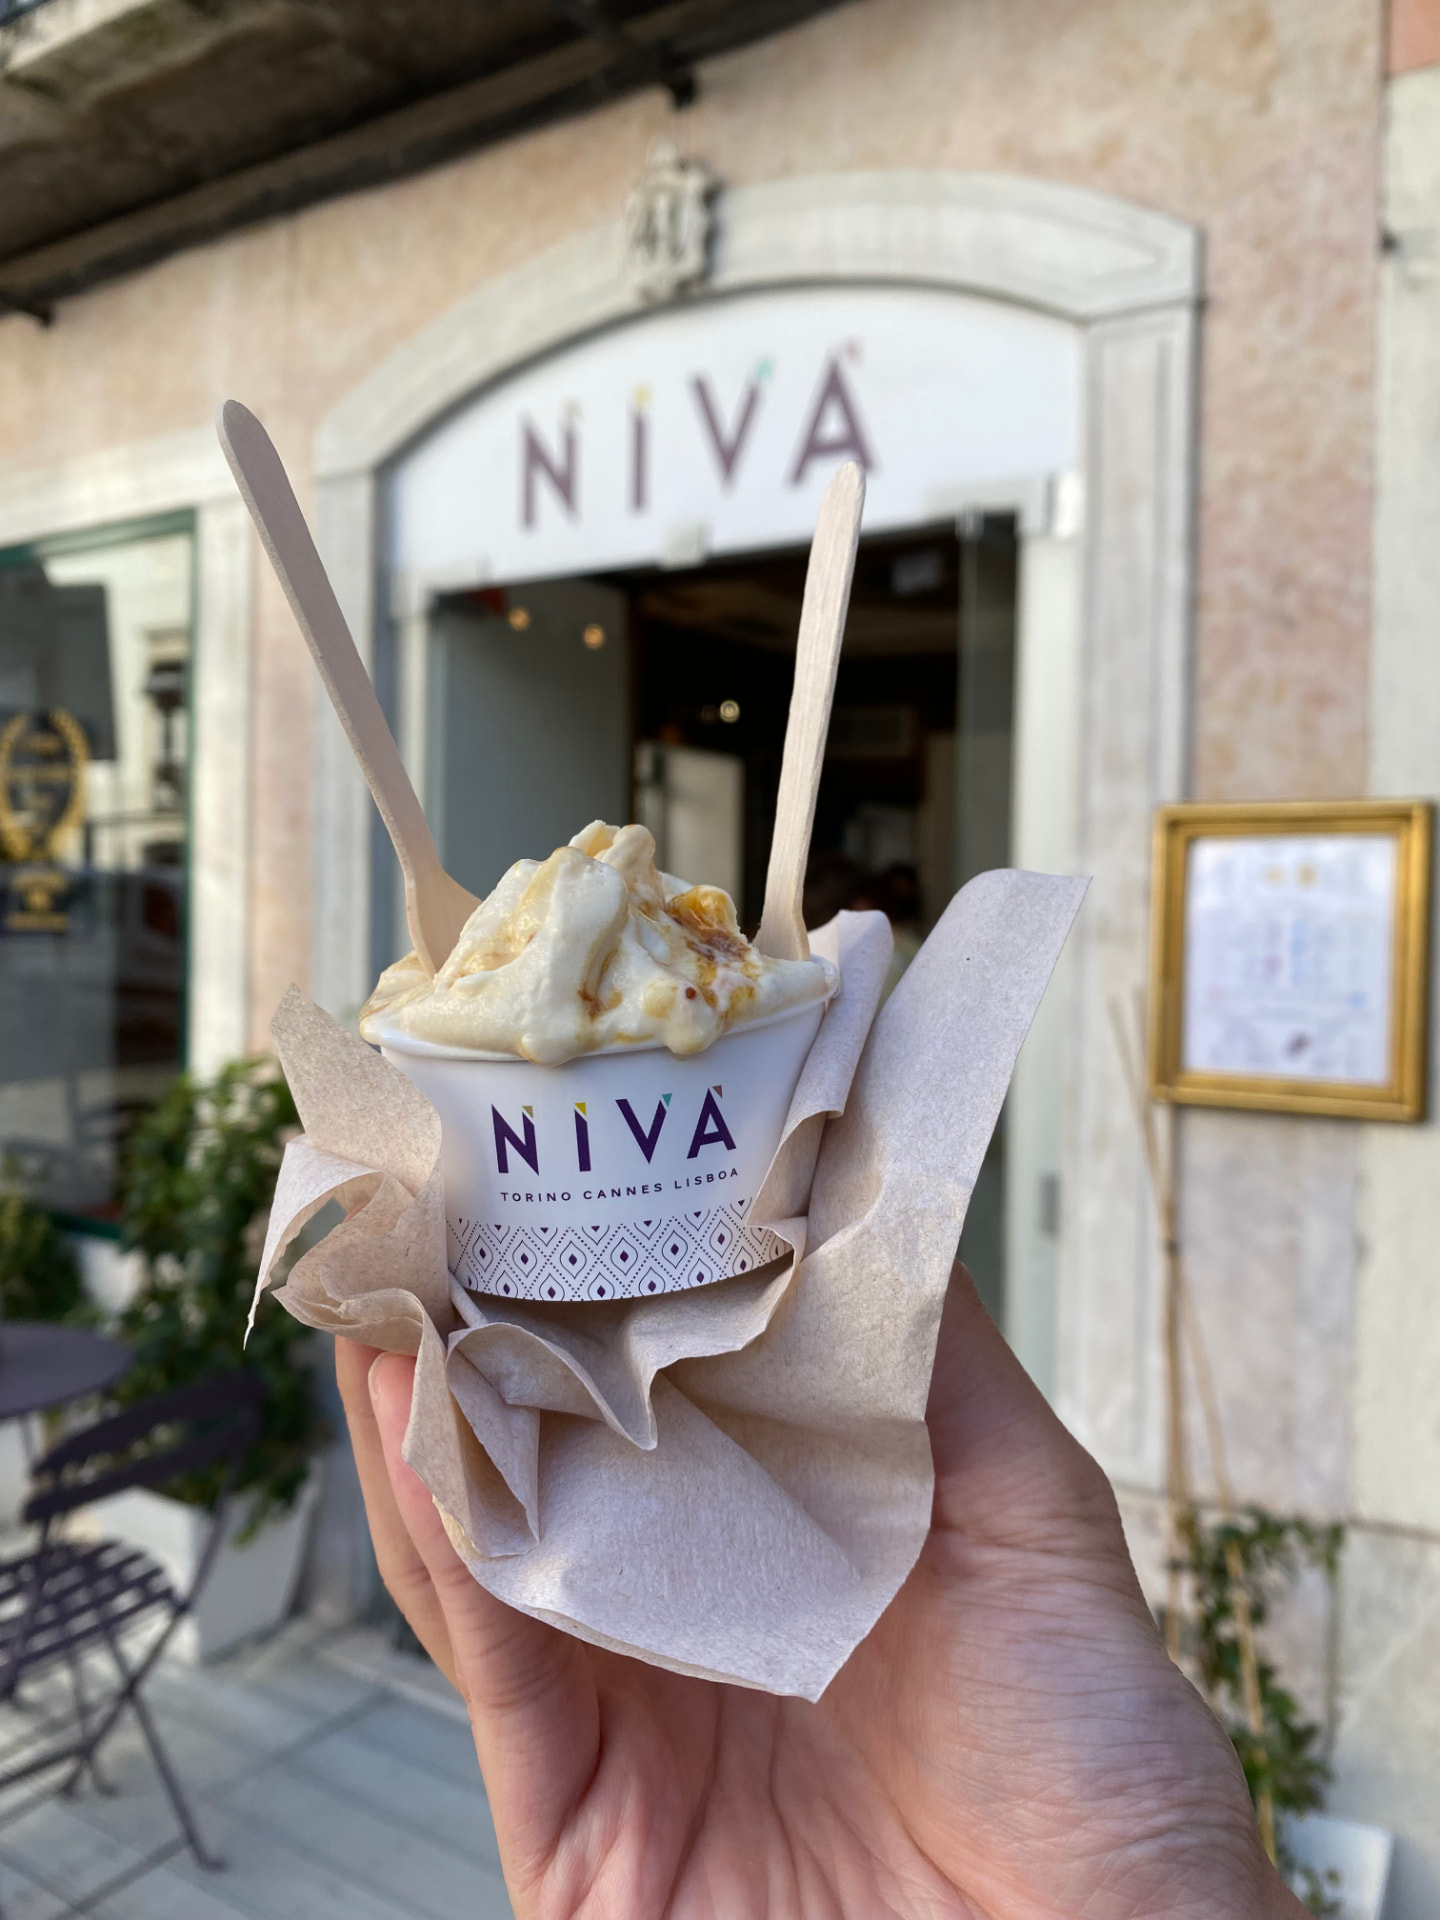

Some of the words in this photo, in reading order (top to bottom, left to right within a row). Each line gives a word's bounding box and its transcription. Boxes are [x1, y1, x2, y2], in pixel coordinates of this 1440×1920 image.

[518, 338, 878, 532] NIVA
[491, 1085, 737, 1176] NIVA
[501, 1191, 571, 1202] TORINO
[583, 1183, 663, 1200] CANNES
[674, 1167, 738, 1190] LISBOA
